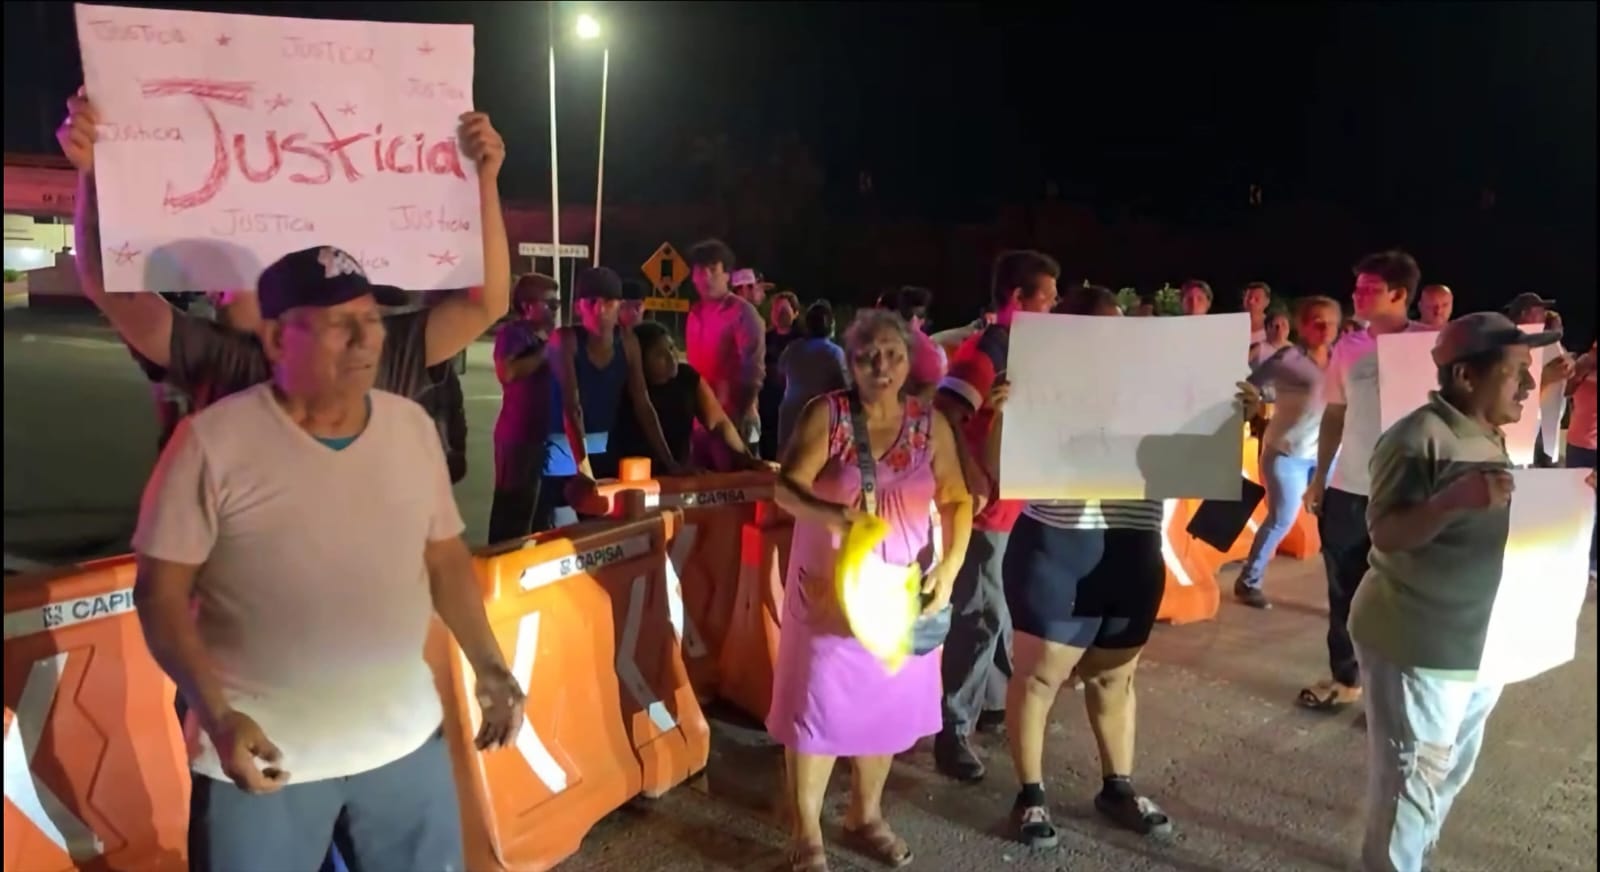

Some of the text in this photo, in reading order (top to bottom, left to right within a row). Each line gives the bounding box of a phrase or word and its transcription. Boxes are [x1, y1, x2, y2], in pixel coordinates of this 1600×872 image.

[140, 77, 468, 212] Justicia
[575, 543, 624, 570] CAPISA
[71, 591, 132, 621] CAPI
